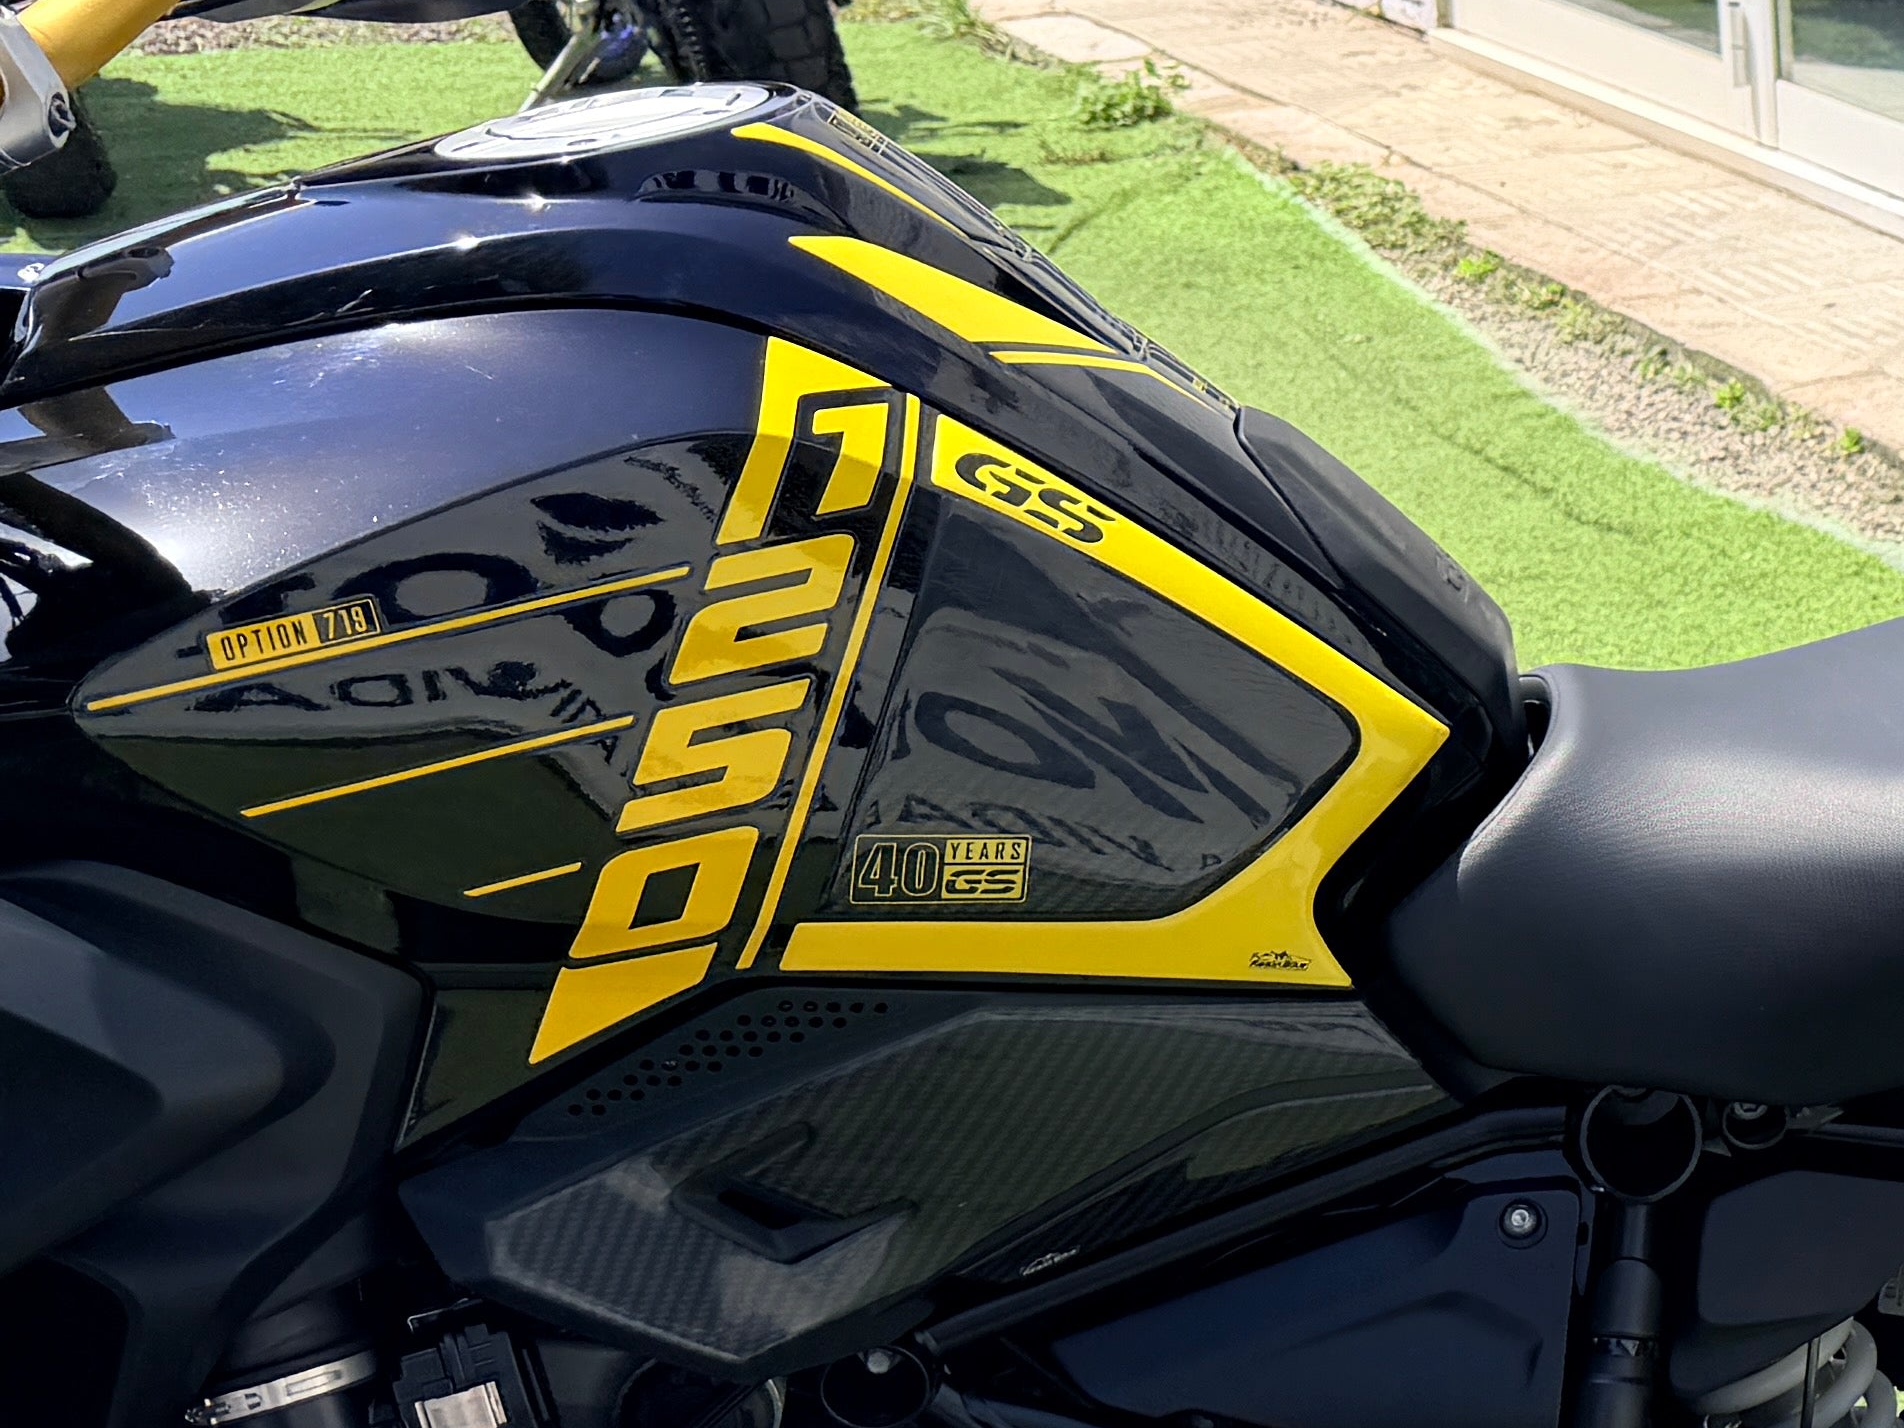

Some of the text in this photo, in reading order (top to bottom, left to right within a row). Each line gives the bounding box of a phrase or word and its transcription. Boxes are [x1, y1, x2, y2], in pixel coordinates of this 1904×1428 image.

[955, 452, 1116, 543] GS
[221, 606, 369, 661] OPTION 719
[568, 401, 890, 960] 1250
[858, 842, 940, 897] 40
[951, 841, 1021, 861] YEARS
[945, 869, 1021, 894] GS
